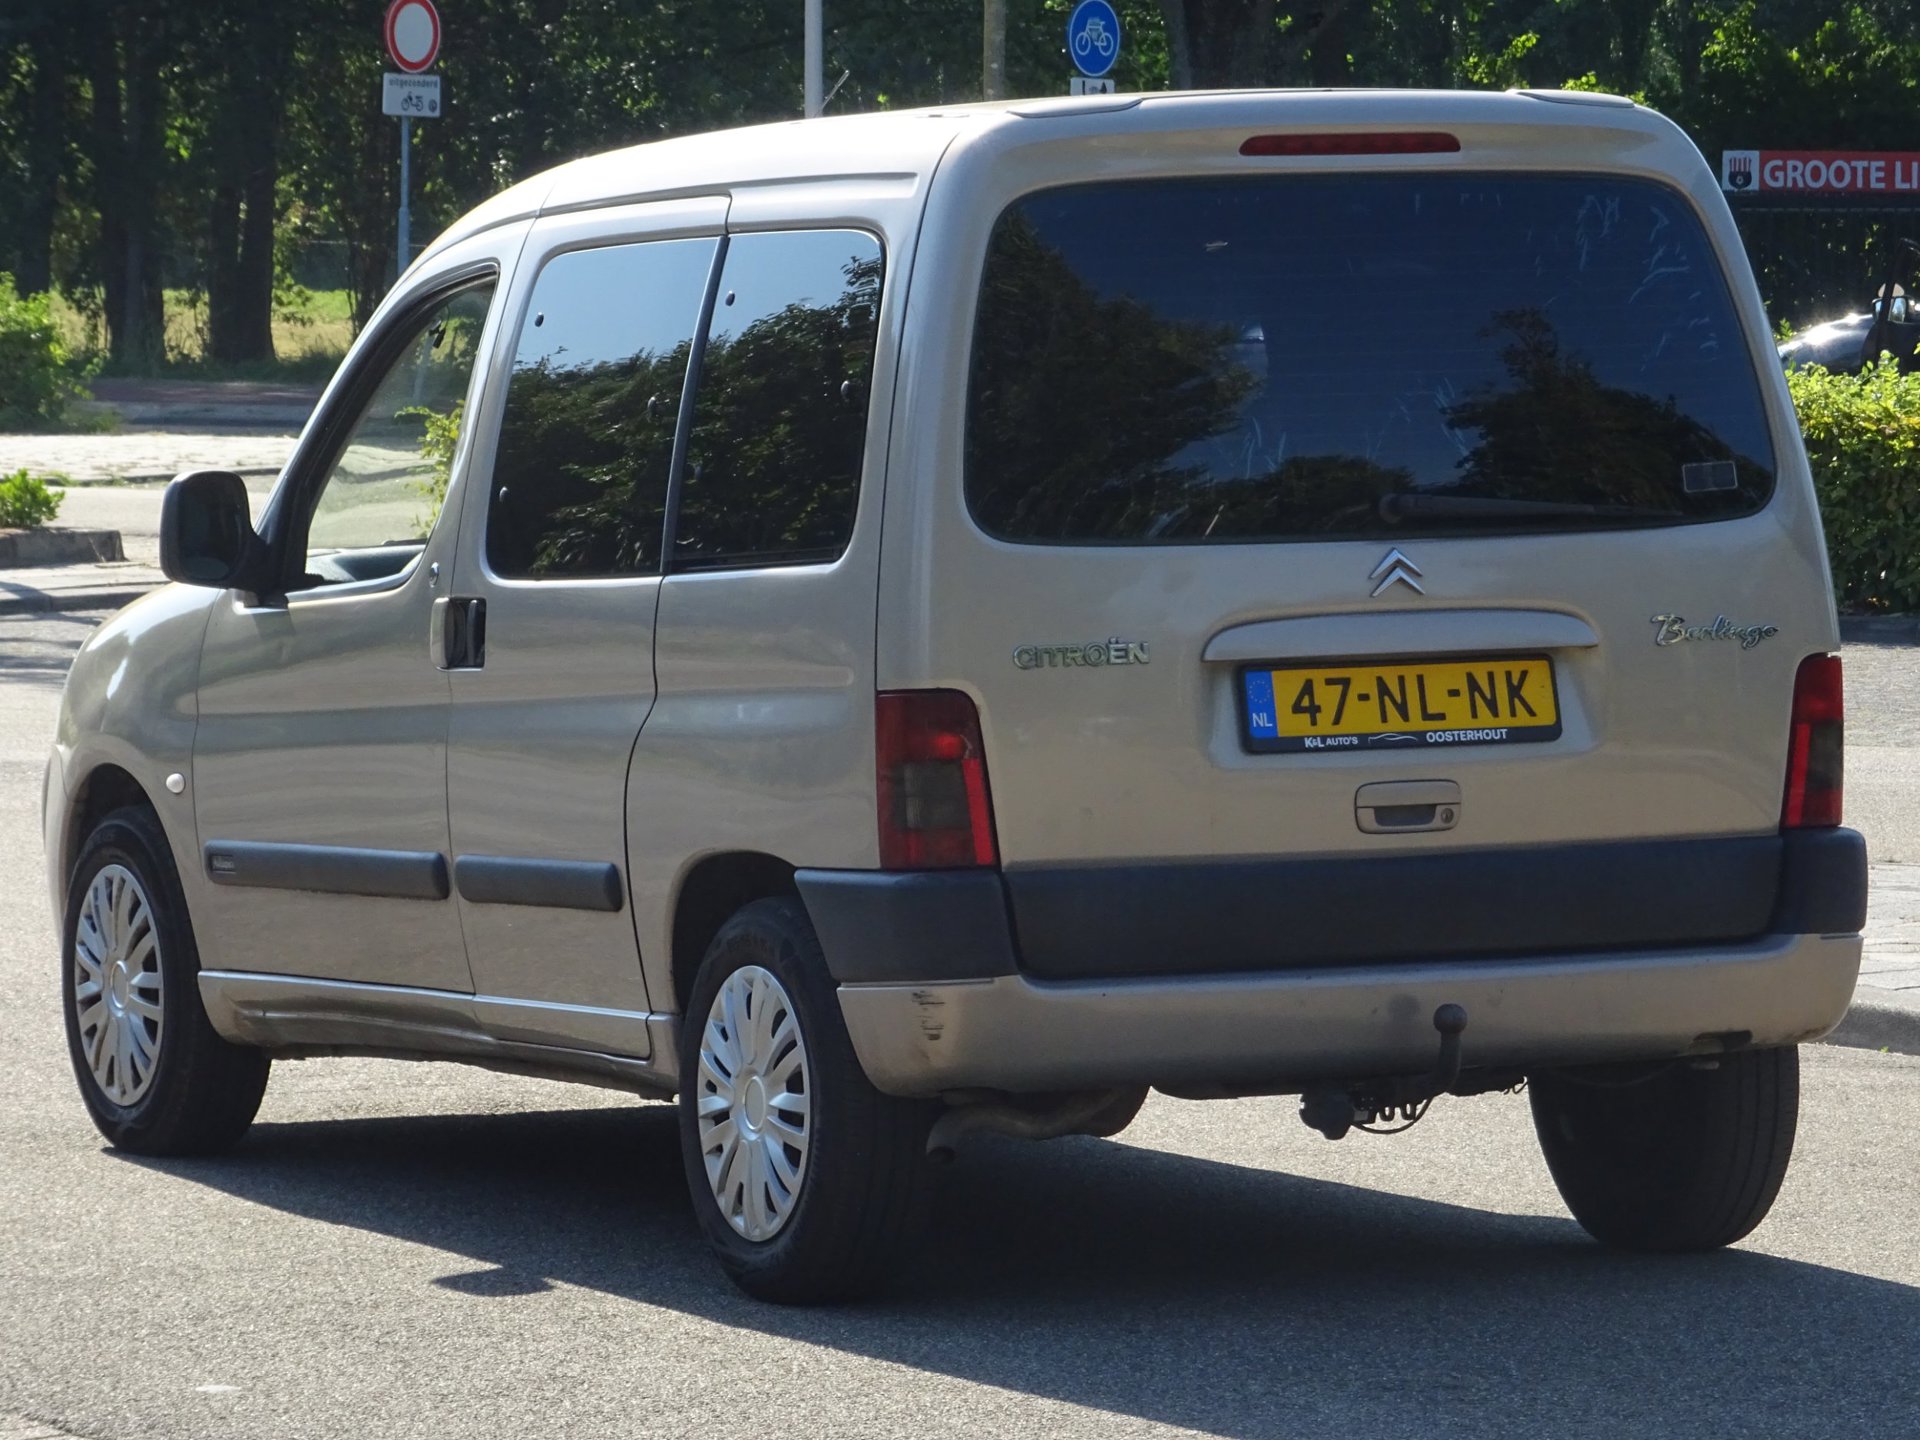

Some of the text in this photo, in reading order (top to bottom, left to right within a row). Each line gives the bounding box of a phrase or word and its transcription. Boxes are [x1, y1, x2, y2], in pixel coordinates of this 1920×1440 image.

[1763, 159, 1886, 189] GROOTE
[1651, 613, 1778, 650] Berlingo
[1013, 637, 1149, 670] CITROËN
[1291, 669, 1537, 727] 47-NL-NK
[1252, 712, 1273, 728] NL
[1426, 729, 1509, 743] OOSTERHOUT
